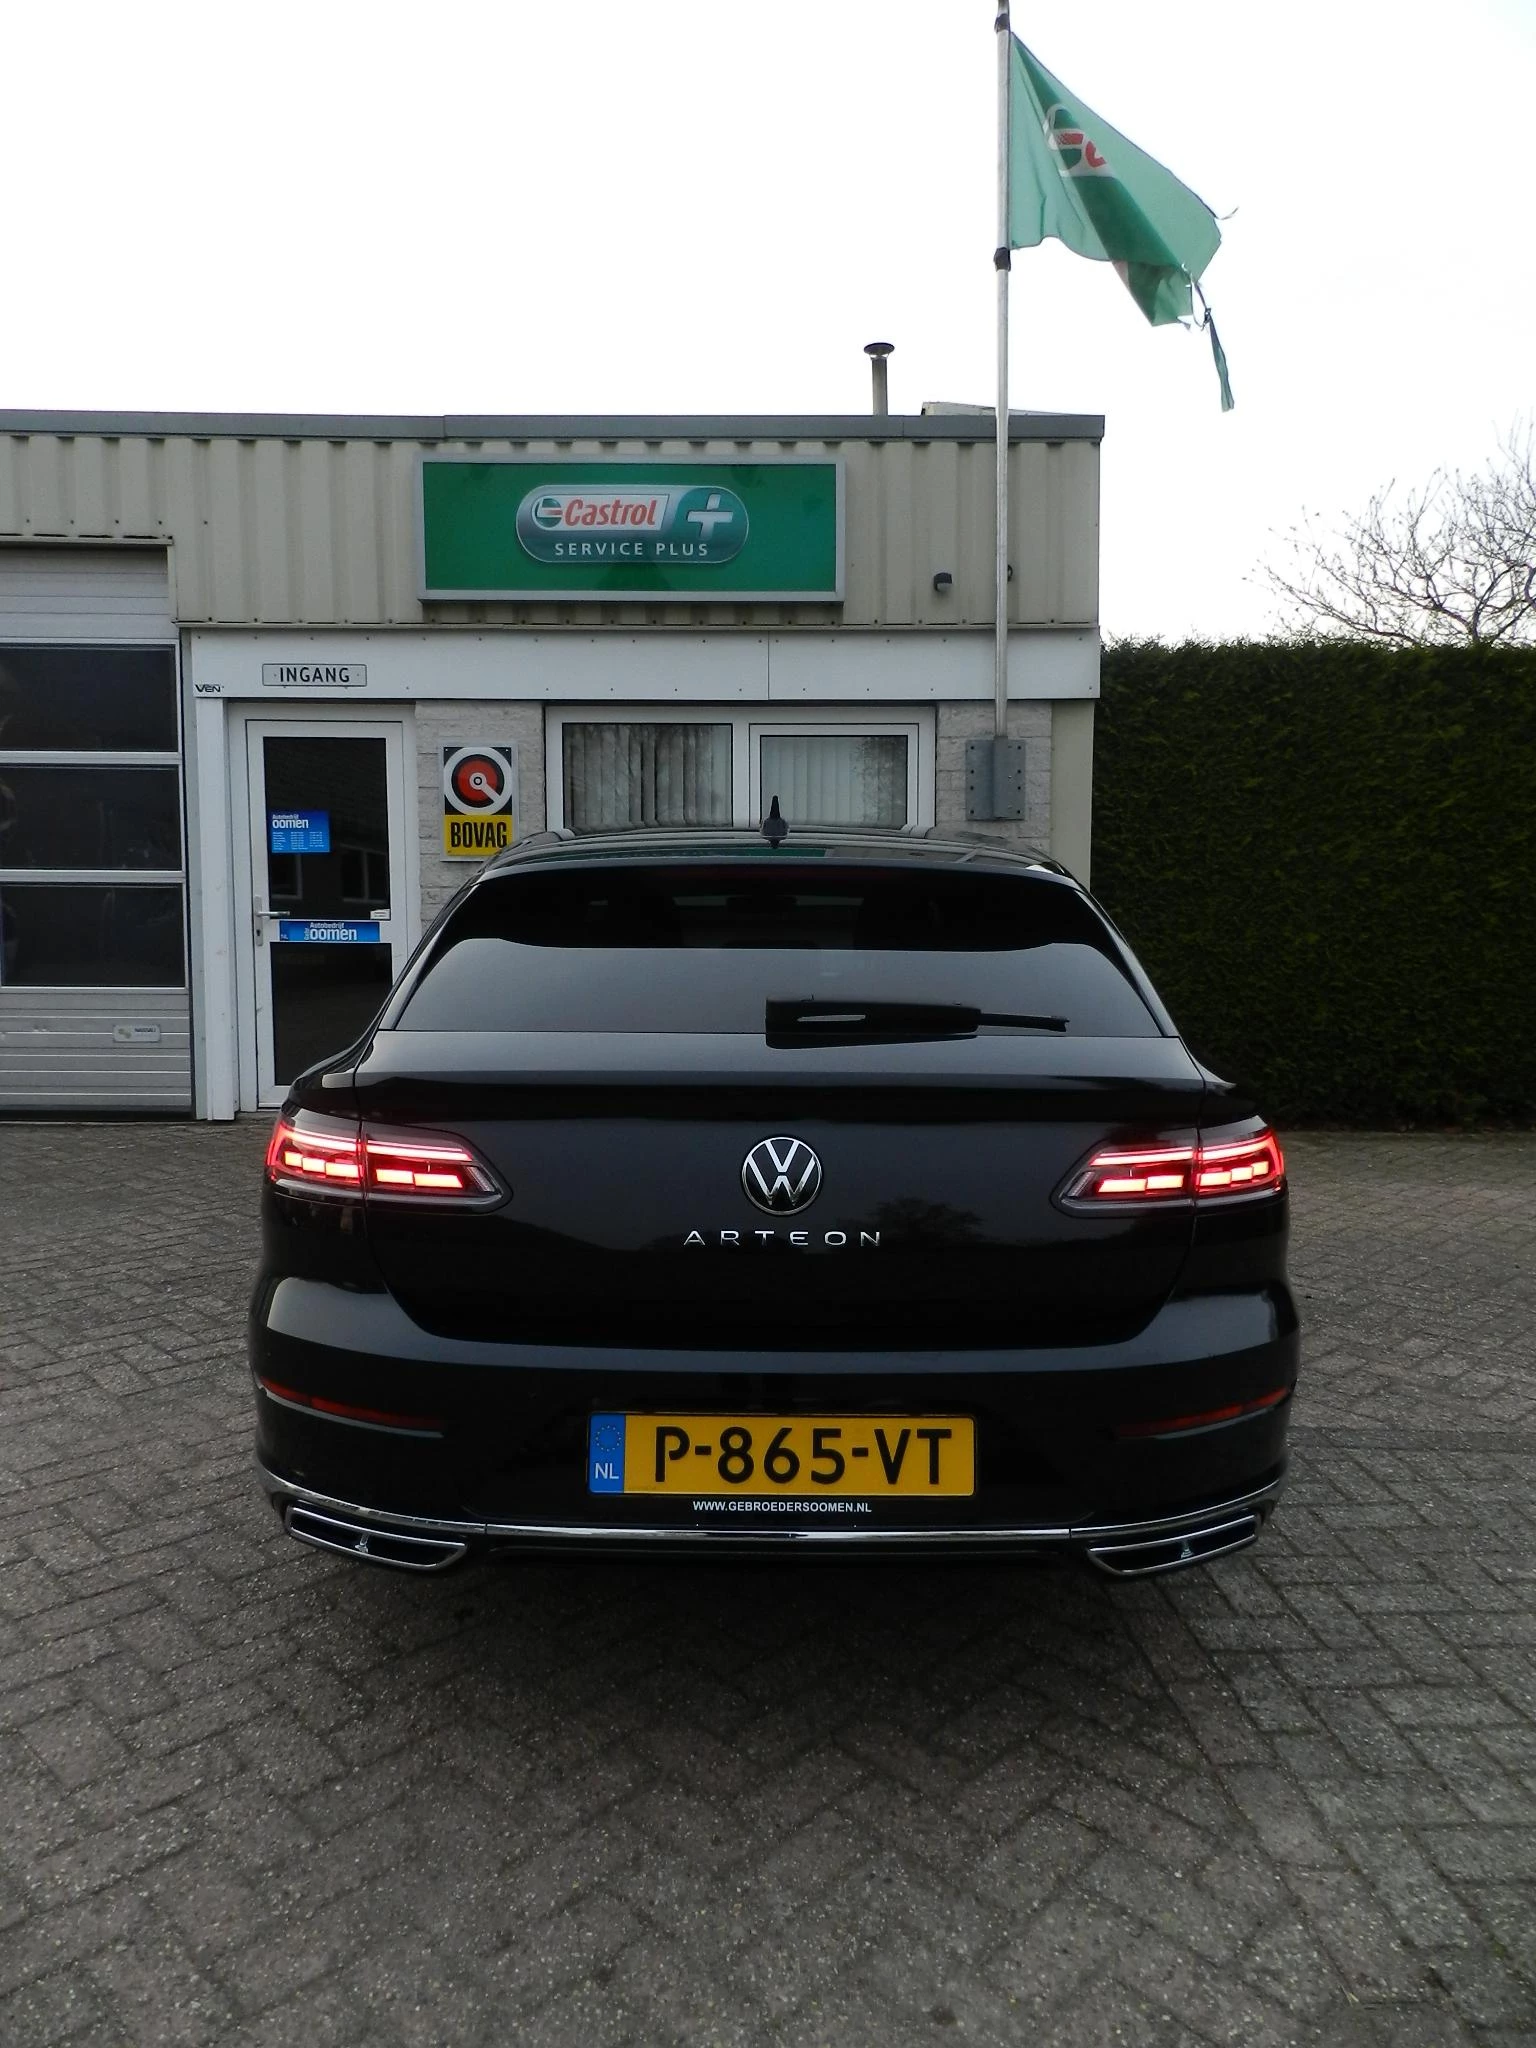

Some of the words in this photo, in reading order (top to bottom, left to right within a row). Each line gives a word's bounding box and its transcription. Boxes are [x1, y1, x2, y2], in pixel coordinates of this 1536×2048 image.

[564, 498, 657, 527] Castrol
[555, 542, 643, 556] SERVICE
[656, 542, 708, 556] PLUS
[280, 667, 350, 683] INGANG
[272, 819, 309, 829] oomen
[450, 822, 507, 848] BOVAG
[310, 922, 345, 930] Autobedrijf
[310, 929, 357, 941] oomen
[683, 1230, 881, 1247] ARTEON
[655, 1426, 952, 1485] P-865-VT
[594, 1462, 620, 1480] NL
[693, 1500, 872, 1513] WWW.GEBROEDERSOOMEN.NL
